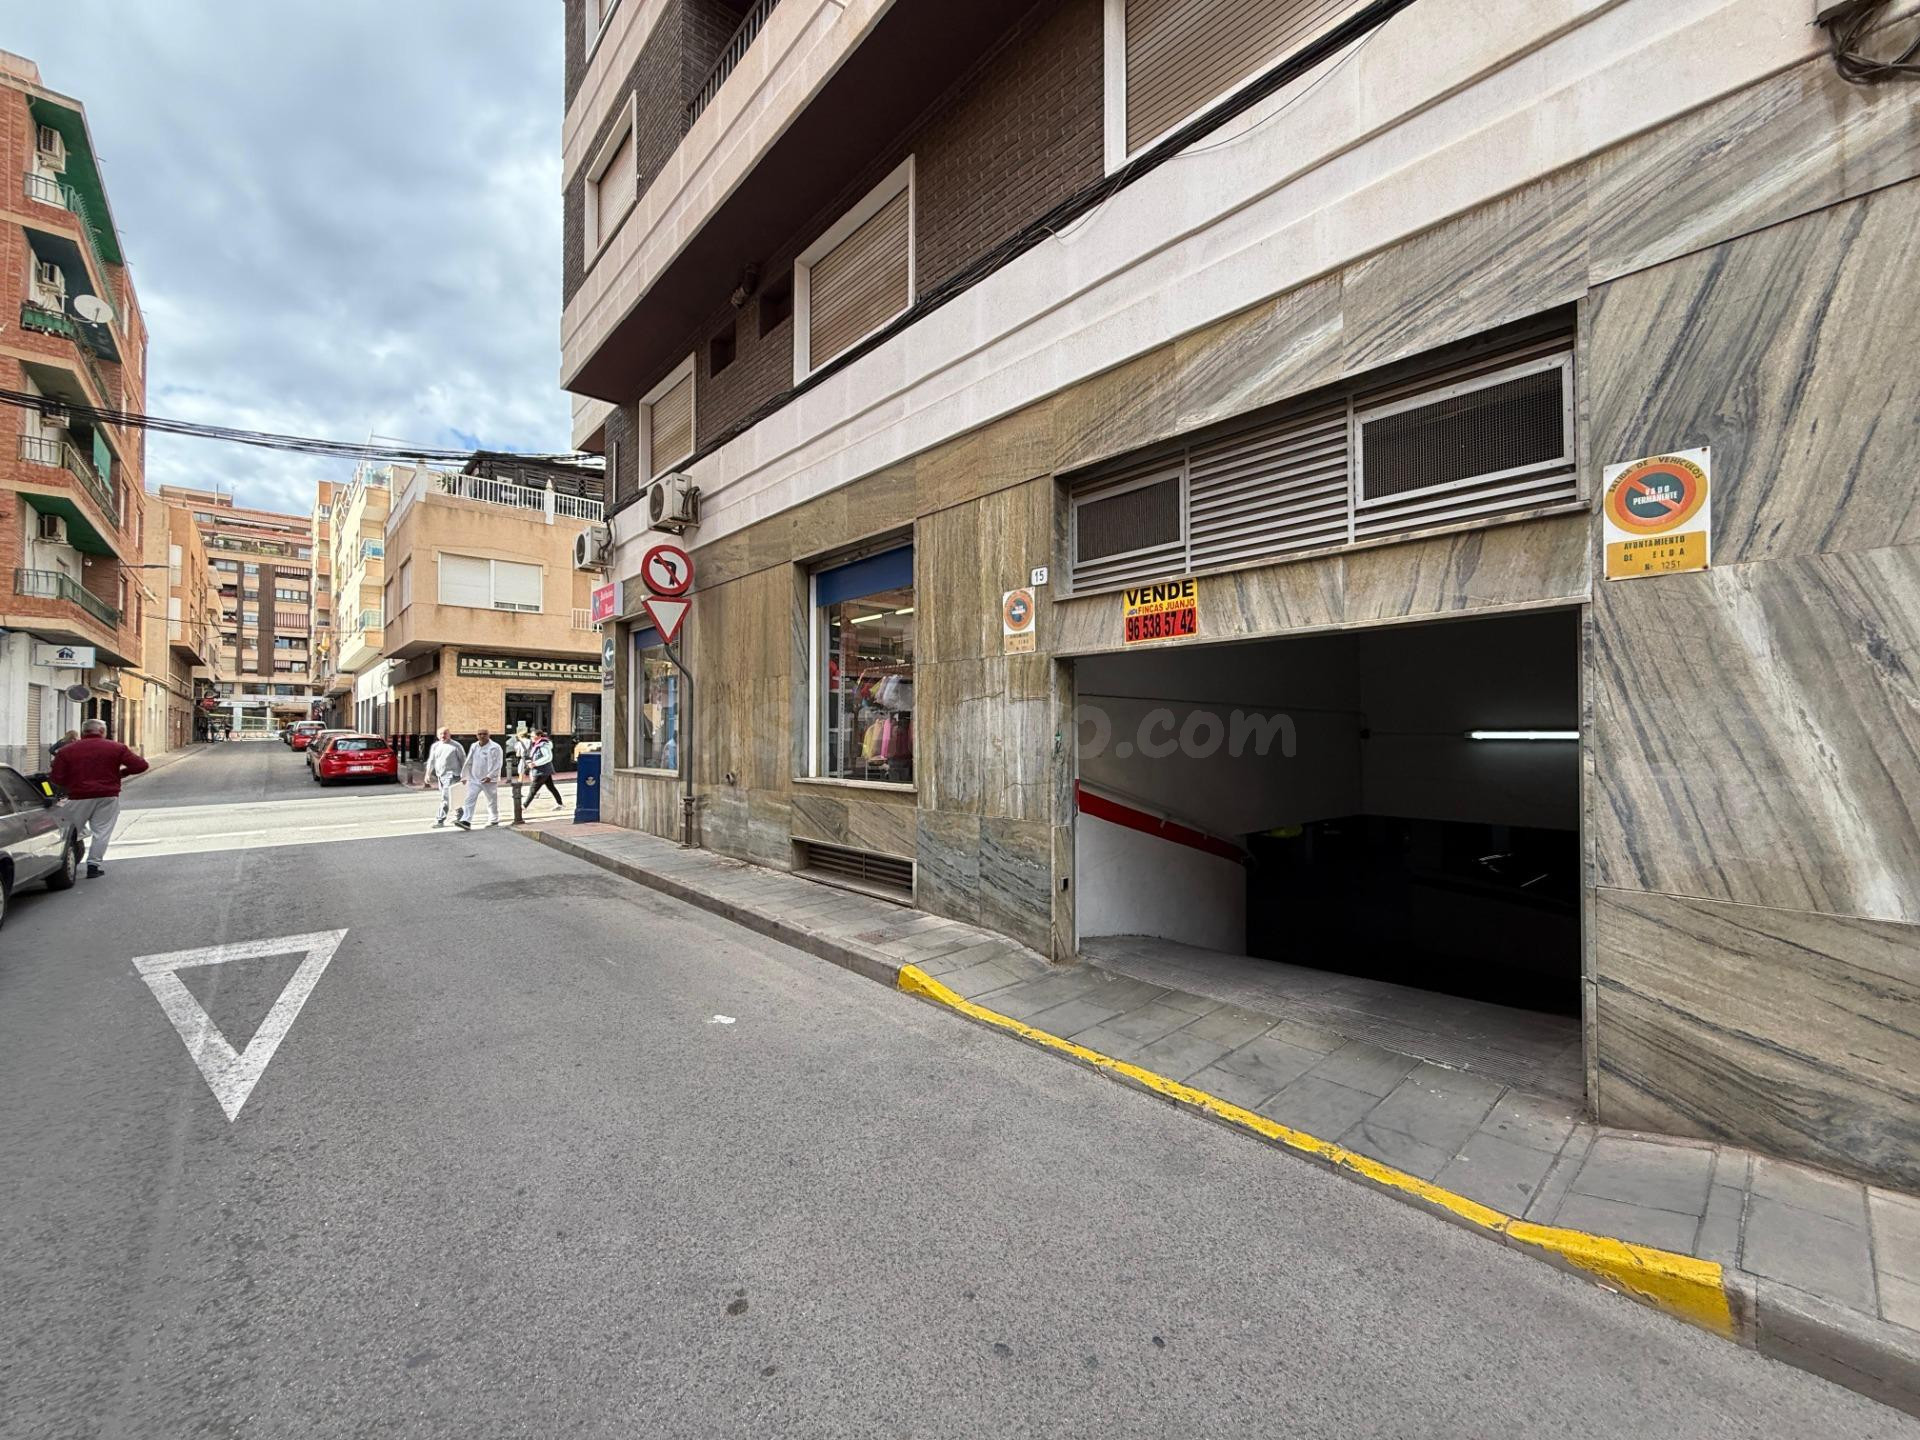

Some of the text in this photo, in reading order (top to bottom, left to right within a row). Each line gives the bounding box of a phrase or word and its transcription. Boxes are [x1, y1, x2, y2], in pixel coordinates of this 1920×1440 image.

[1636, 459, 1649, 468] DE
[1658, 456, 1704, 479] VEHICULOS
[1633, 491, 1678, 506] PERMANENTE
[1624, 535, 1686, 550] AYUNTAMIENTO
[1034, 570, 1045, 583] 15
[1126, 579, 1194, 607] VENDE
[1138, 603, 1164, 615] FINCAS
[1165, 598, 1195, 611] JUANJO
[1127, 608, 1194, 641] 96 538 57 42
[461, 658, 510, 669] INST.
